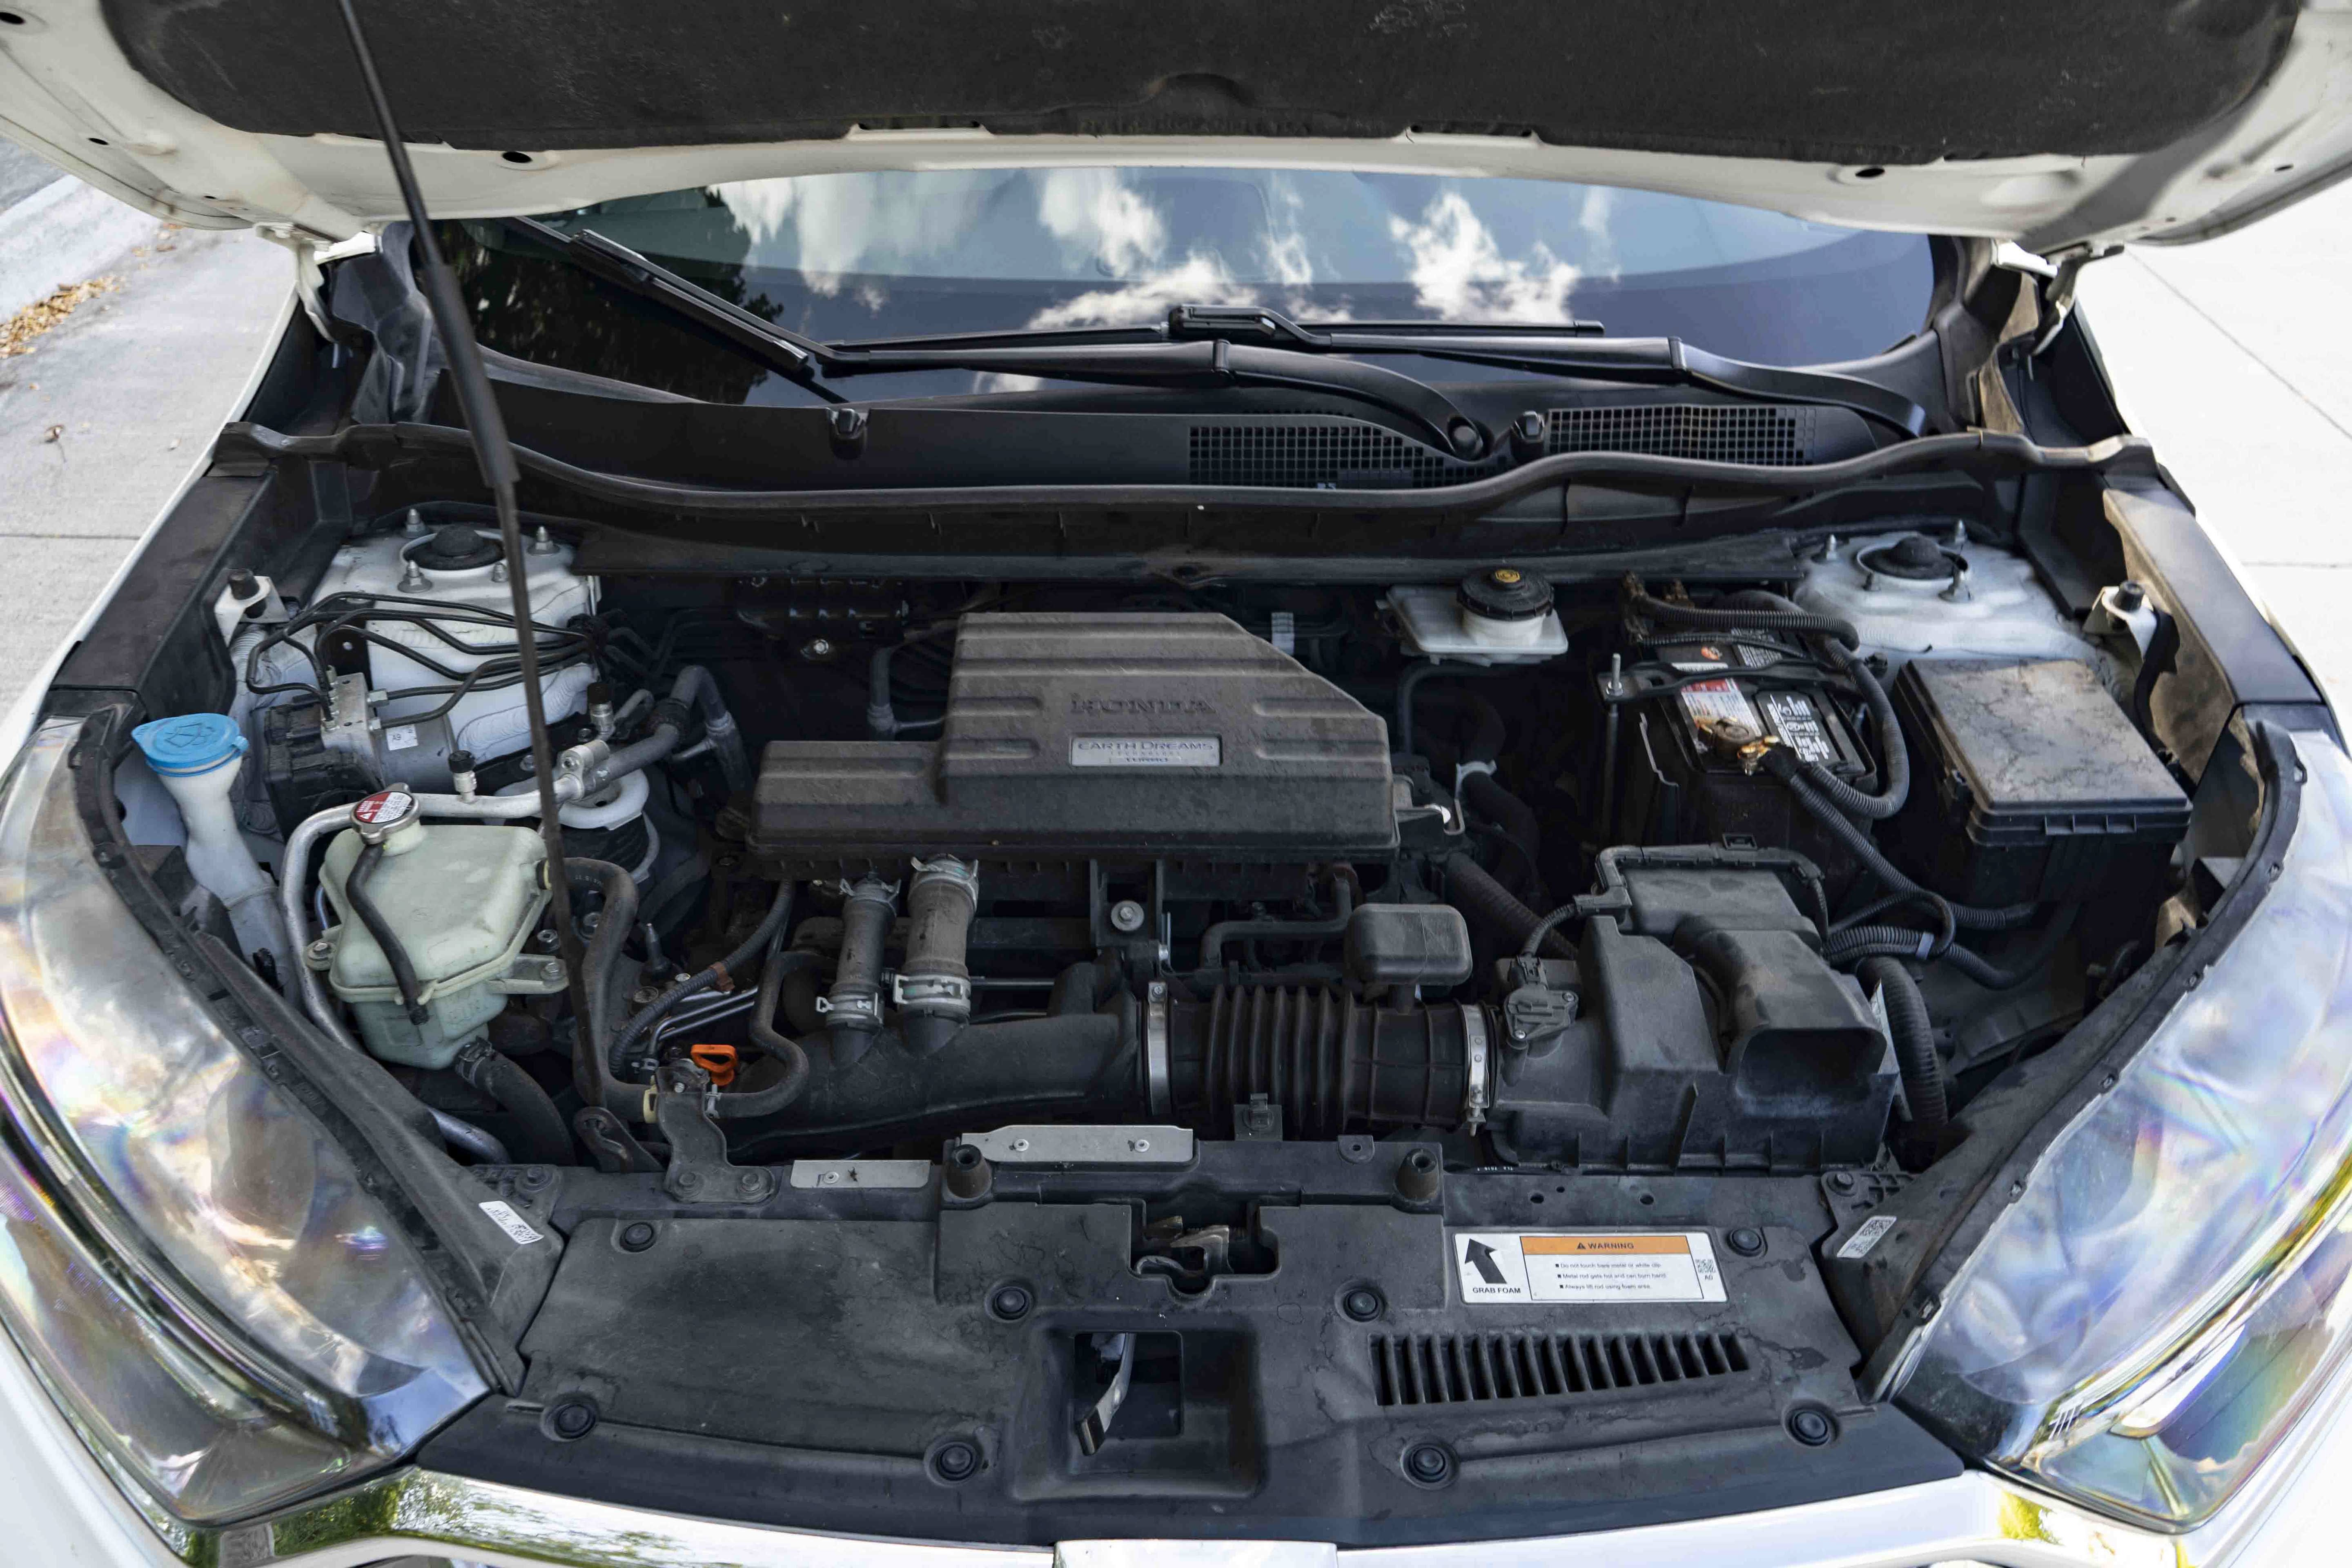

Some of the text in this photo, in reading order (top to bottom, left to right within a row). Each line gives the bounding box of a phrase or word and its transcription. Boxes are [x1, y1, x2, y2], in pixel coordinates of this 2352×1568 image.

[1071, 699, 1219, 714] HONDA
[1078, 741, 1213, 750] EARTH DREAMS
